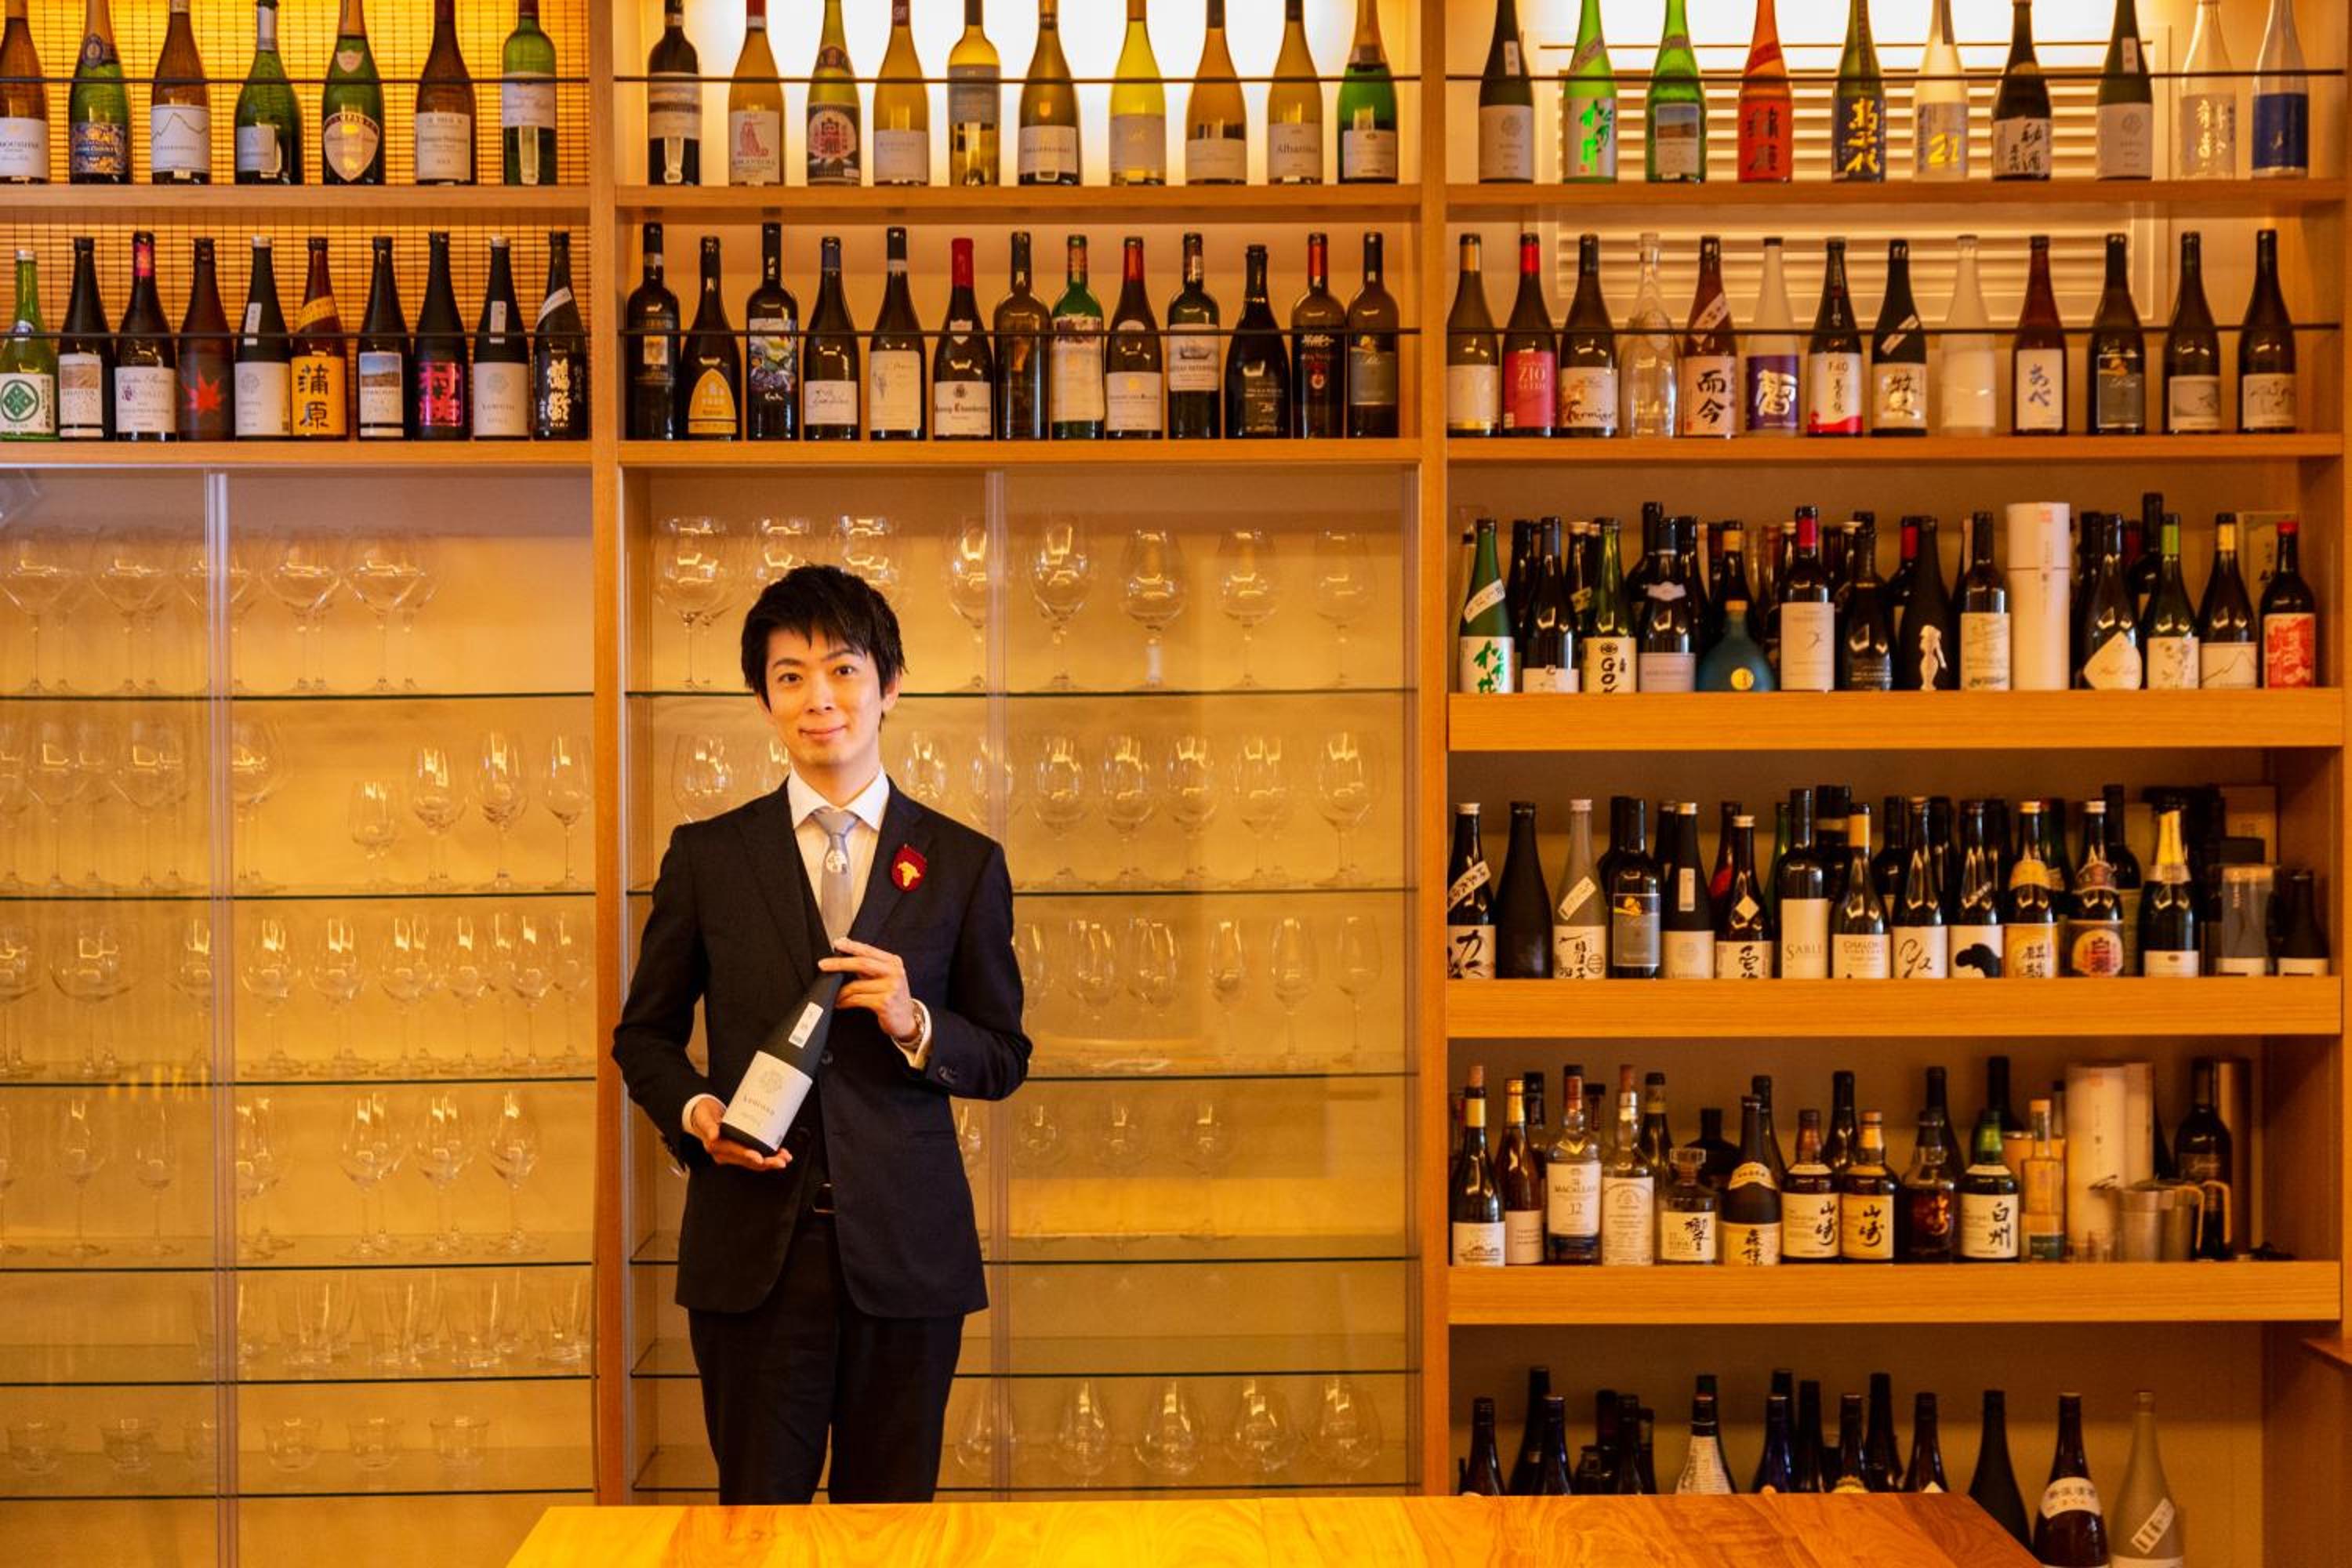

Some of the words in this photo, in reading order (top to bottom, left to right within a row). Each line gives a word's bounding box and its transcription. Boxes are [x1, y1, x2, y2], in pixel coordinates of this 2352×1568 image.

[299, 364, 328, 429] 蒲原
[1697, 370, 1726, 424] 而今
[1988, 1201, 2012, 1249] 白州
